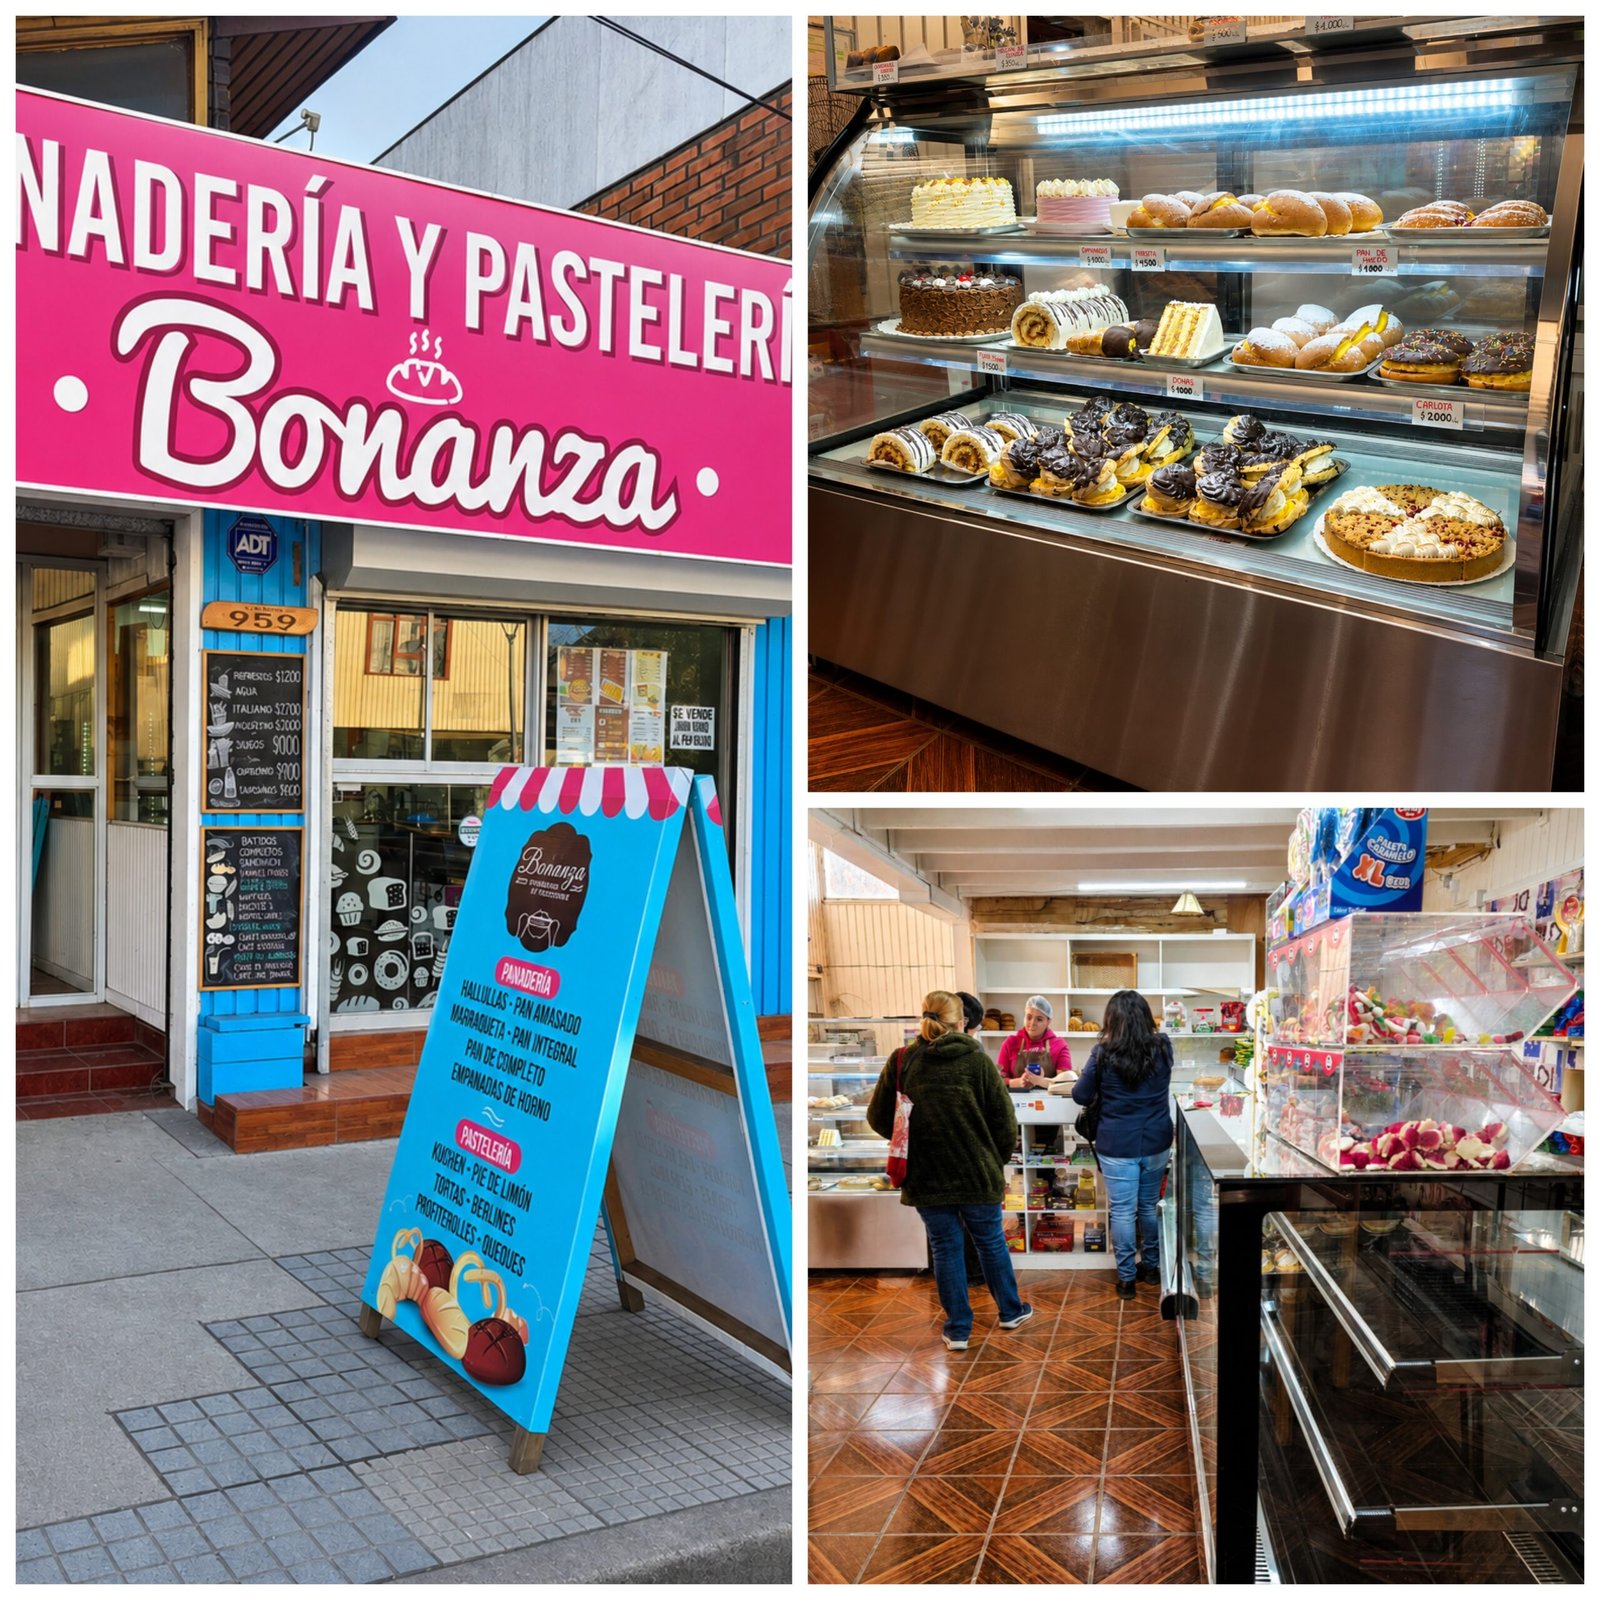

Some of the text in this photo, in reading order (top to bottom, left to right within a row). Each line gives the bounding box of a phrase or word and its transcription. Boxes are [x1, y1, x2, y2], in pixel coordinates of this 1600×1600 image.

[395, 215, 446, 319] Y
[1172, 377, 1194, 386] DONAS
[116, 297, 679, 532] Bonanza
[1416, 400, 1453, 411] CARLOTA
[235, 534, 272, 555] ADT
[229, 610, 297, 631] 959
[275, 670, 301, 683] $1200
[232, 704, 273, 714] ITALIANO
[672, 707, 713, 720] SE VENDE
[241, 836, 277, 846] BATIDOS
[517, 846, 587, 890] Bonanza
[1353, 853, 1385, 888] XL
[501, 962, 552, 996] PANADERÍA
[461, 979, 582, 1036] HALLULLAS PAN AMASADO
[450, 1003, 578, 1068] MARRAQUETA PAN INTEGRAL
[464, 1038, 546, 1087] PAN DE COMPLETO
[451, 1062, 552, 1122] EMPANADAS DE HORNO
[460, 1125, 513, 1170] PASTELERÍA
[432, 1141, 533, 1212] KUCHEN PIE DE LIMÓN
[433, 1172, 517, 1237] TORTAS BERLINES
[481, 1234, 527, 1277] QUEQUES
